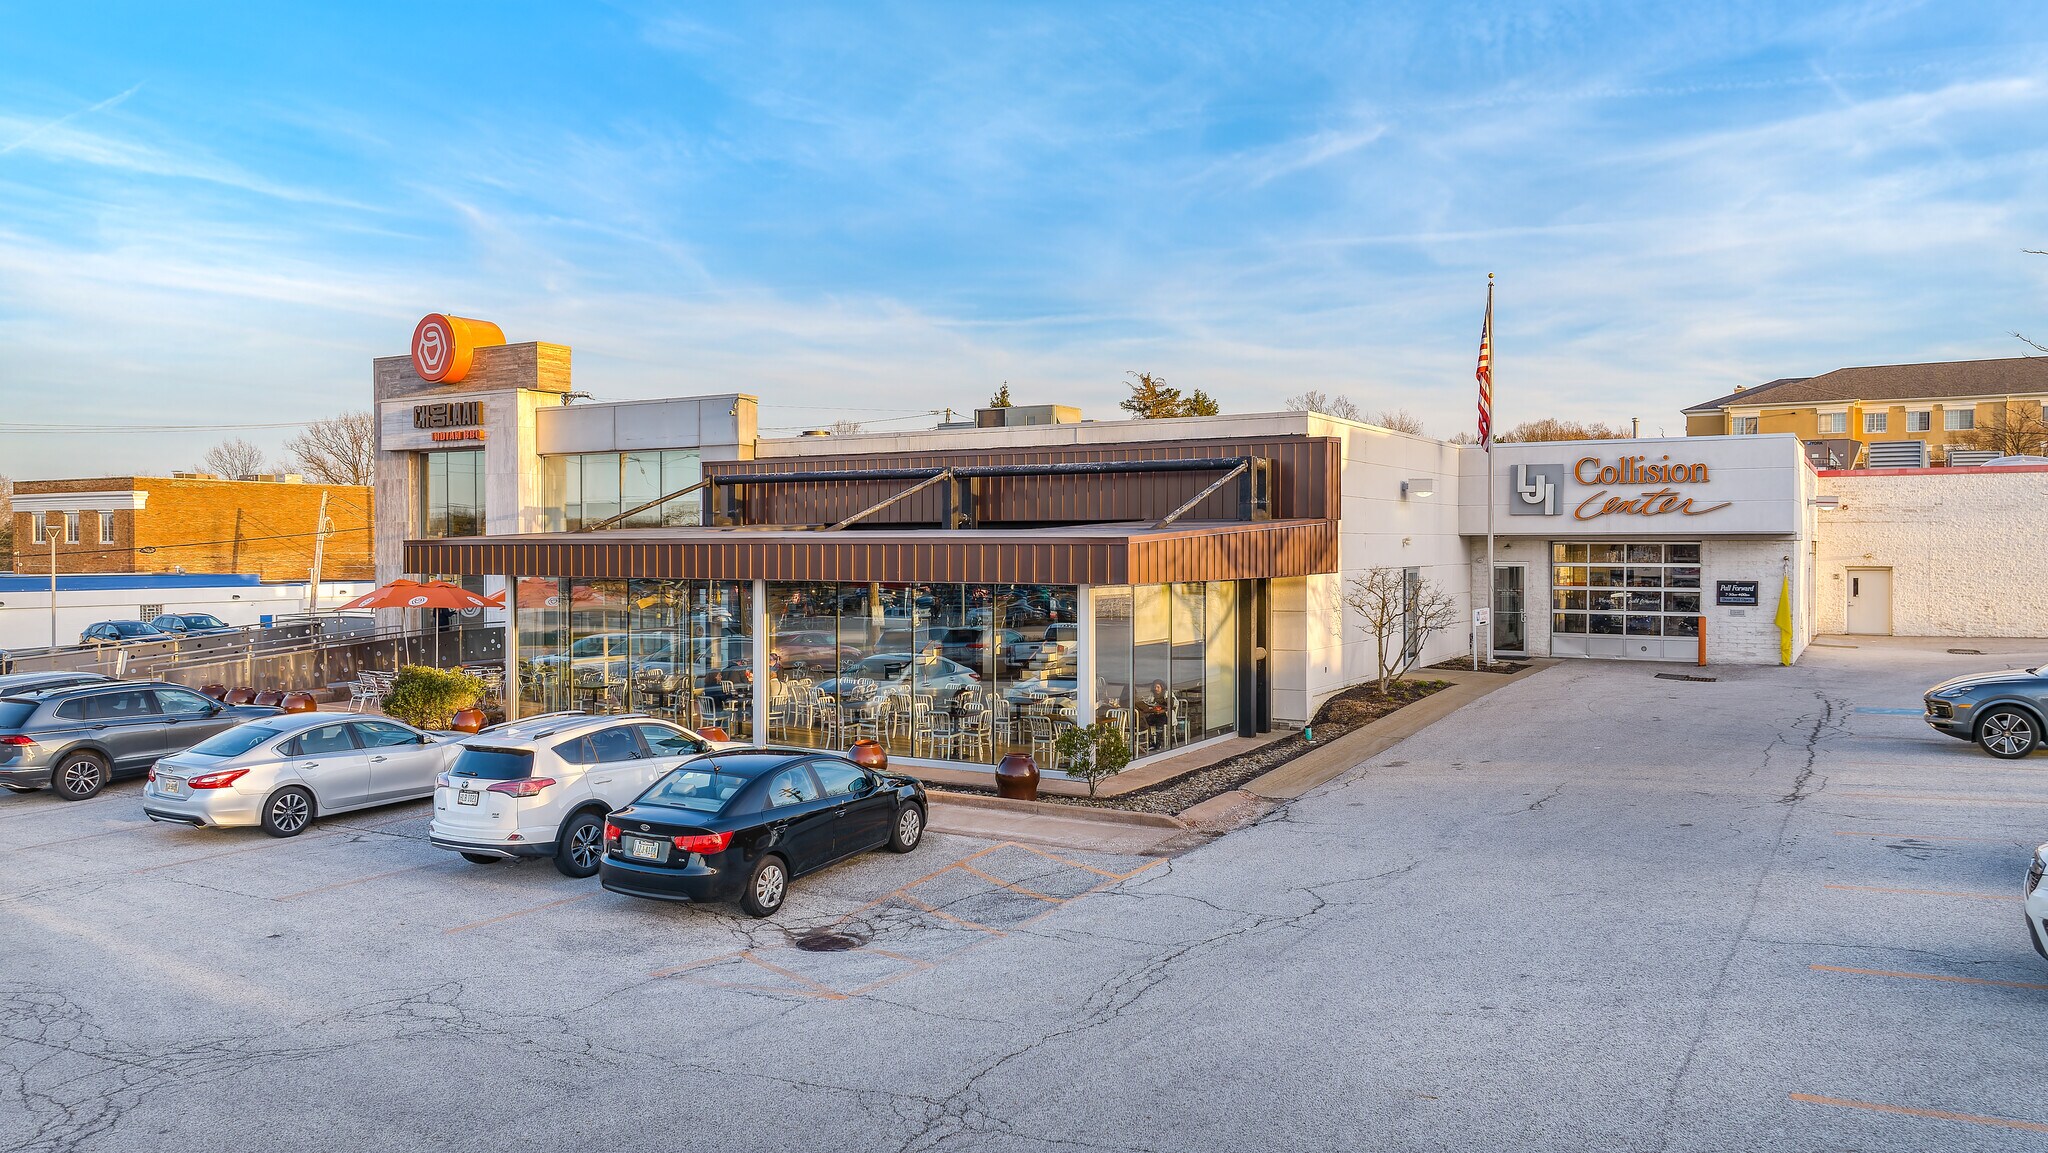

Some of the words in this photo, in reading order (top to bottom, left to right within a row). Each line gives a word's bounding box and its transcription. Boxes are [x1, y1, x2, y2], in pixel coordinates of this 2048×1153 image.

[431, 431, 463, 441] INDIAN
[463, 429, 485, 441] BBQ
[1573, 454, 1710, 486] Collision
[1573, 487, 1733, 522] Center
[1720, 584, 1732, 592] Pull
[1731, 584, 1755, 592] Forward
